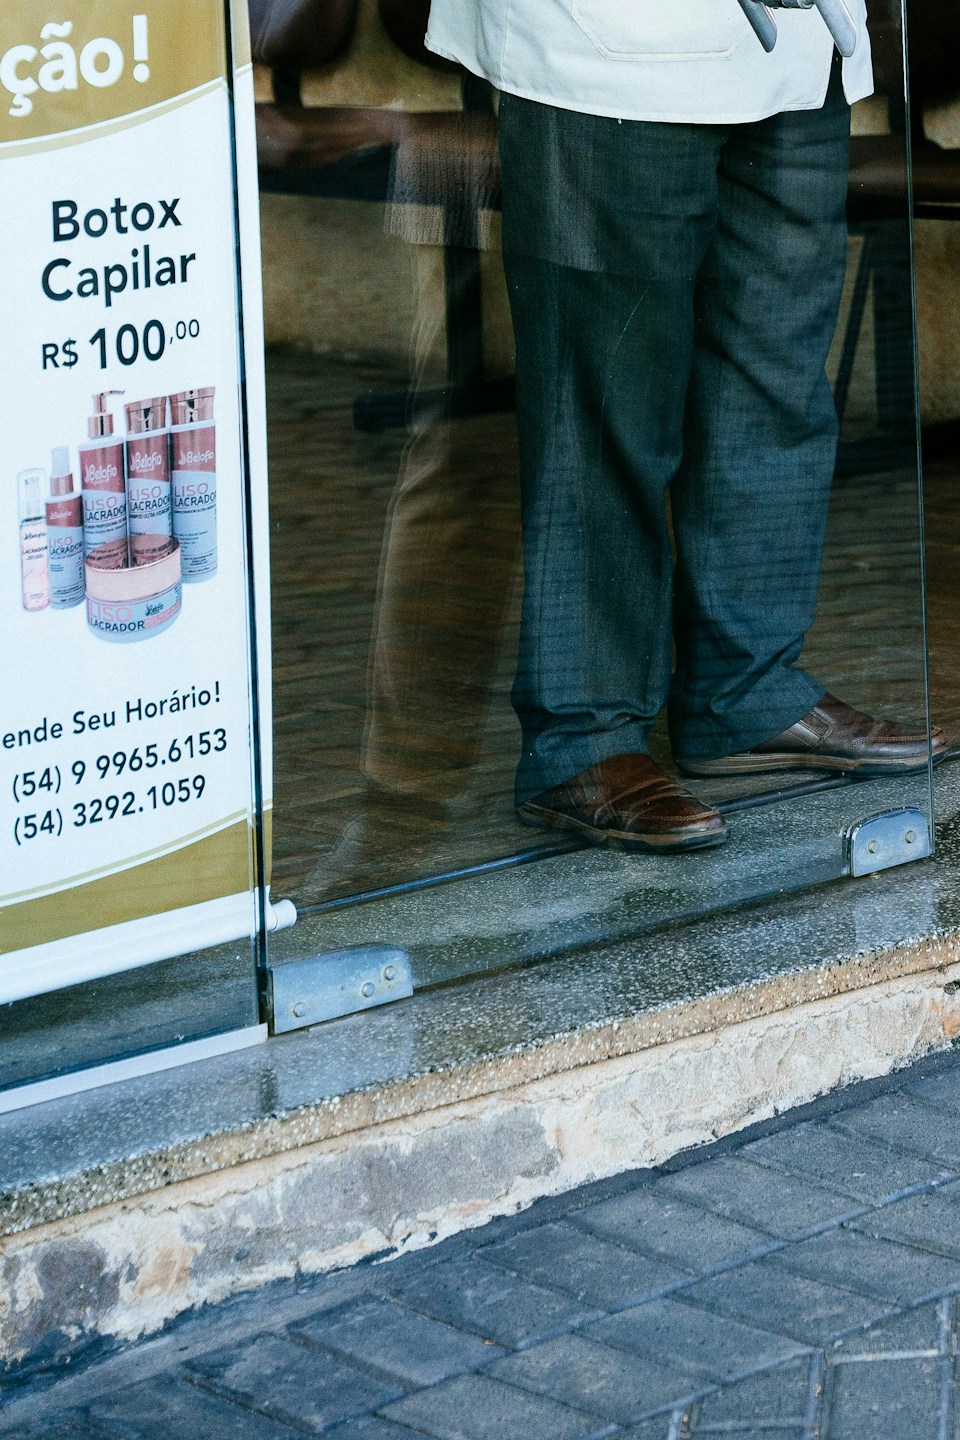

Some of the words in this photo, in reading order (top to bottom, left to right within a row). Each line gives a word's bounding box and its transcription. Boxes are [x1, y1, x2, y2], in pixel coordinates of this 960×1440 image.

[0, 14, 150, 117] ção!
[51, 196, 182, 243] Botox
[41, 245, 197, 306] Capilar
[41, 336, 79, 371] R$
[84, 496, 117, 512] LISO
[129, 485, 162, 501] LISO
[173, 482, 209, 498] LISO
[90, 617, 146, 633] LACRADOR
[2, 716, 64, 750] ende
[72, 710, 117, 735] Seu
[125, 681, 222, 724] Horário!
[12, 763, 62, 803] (54)
[71, 760, 87, 785] 9
[95, 727, 228, 780] 9965.6153
[14, 807, 63, 846] (54)
[72, 774, 207, 828] 3292.1059
